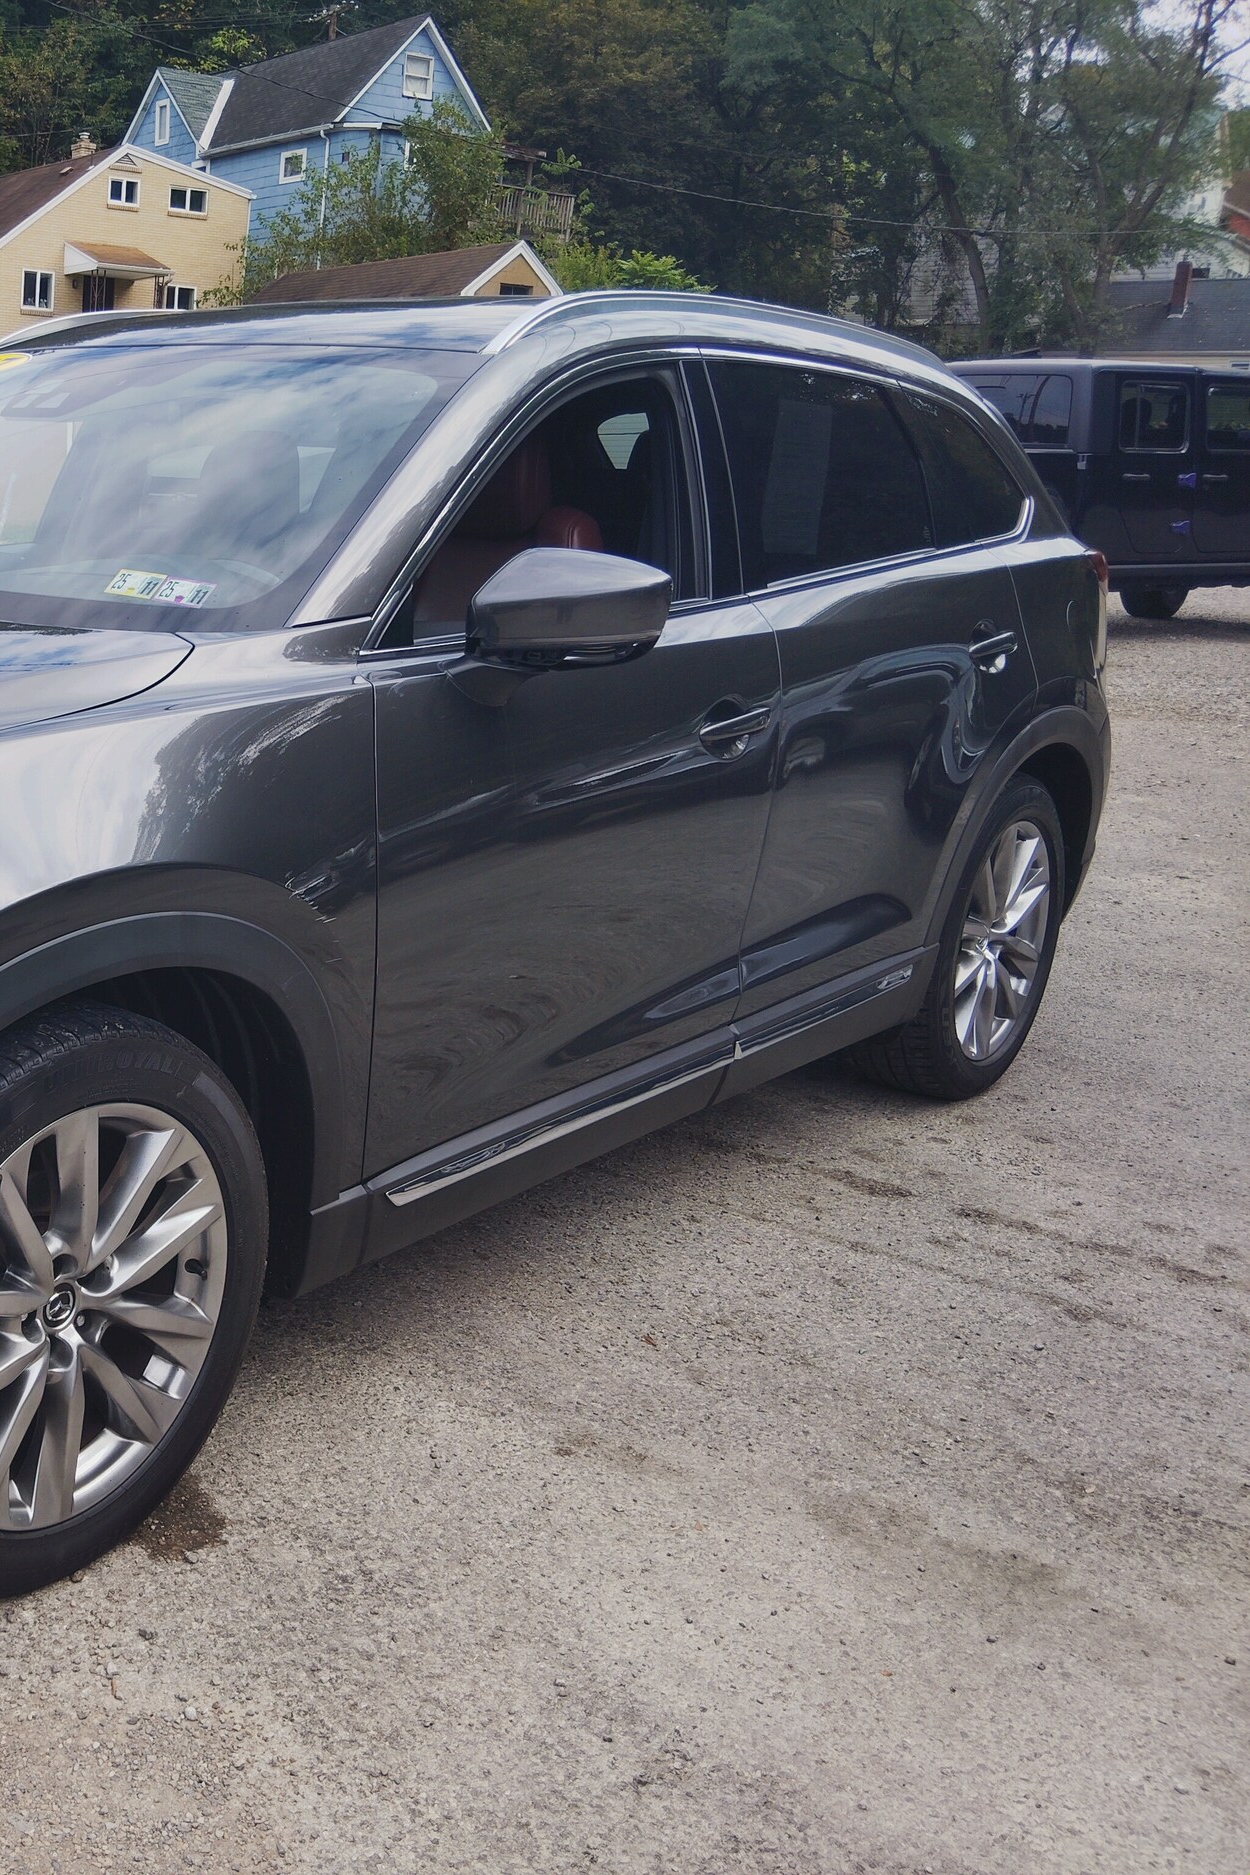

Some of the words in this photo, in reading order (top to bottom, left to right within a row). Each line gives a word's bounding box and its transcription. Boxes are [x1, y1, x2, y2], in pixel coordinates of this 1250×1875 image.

[111, 573, 132, 590] 25
[139, 580, 160, 596] 11
[159, 580, 180, 598] 25
[190, 588, 209, 605] 11
